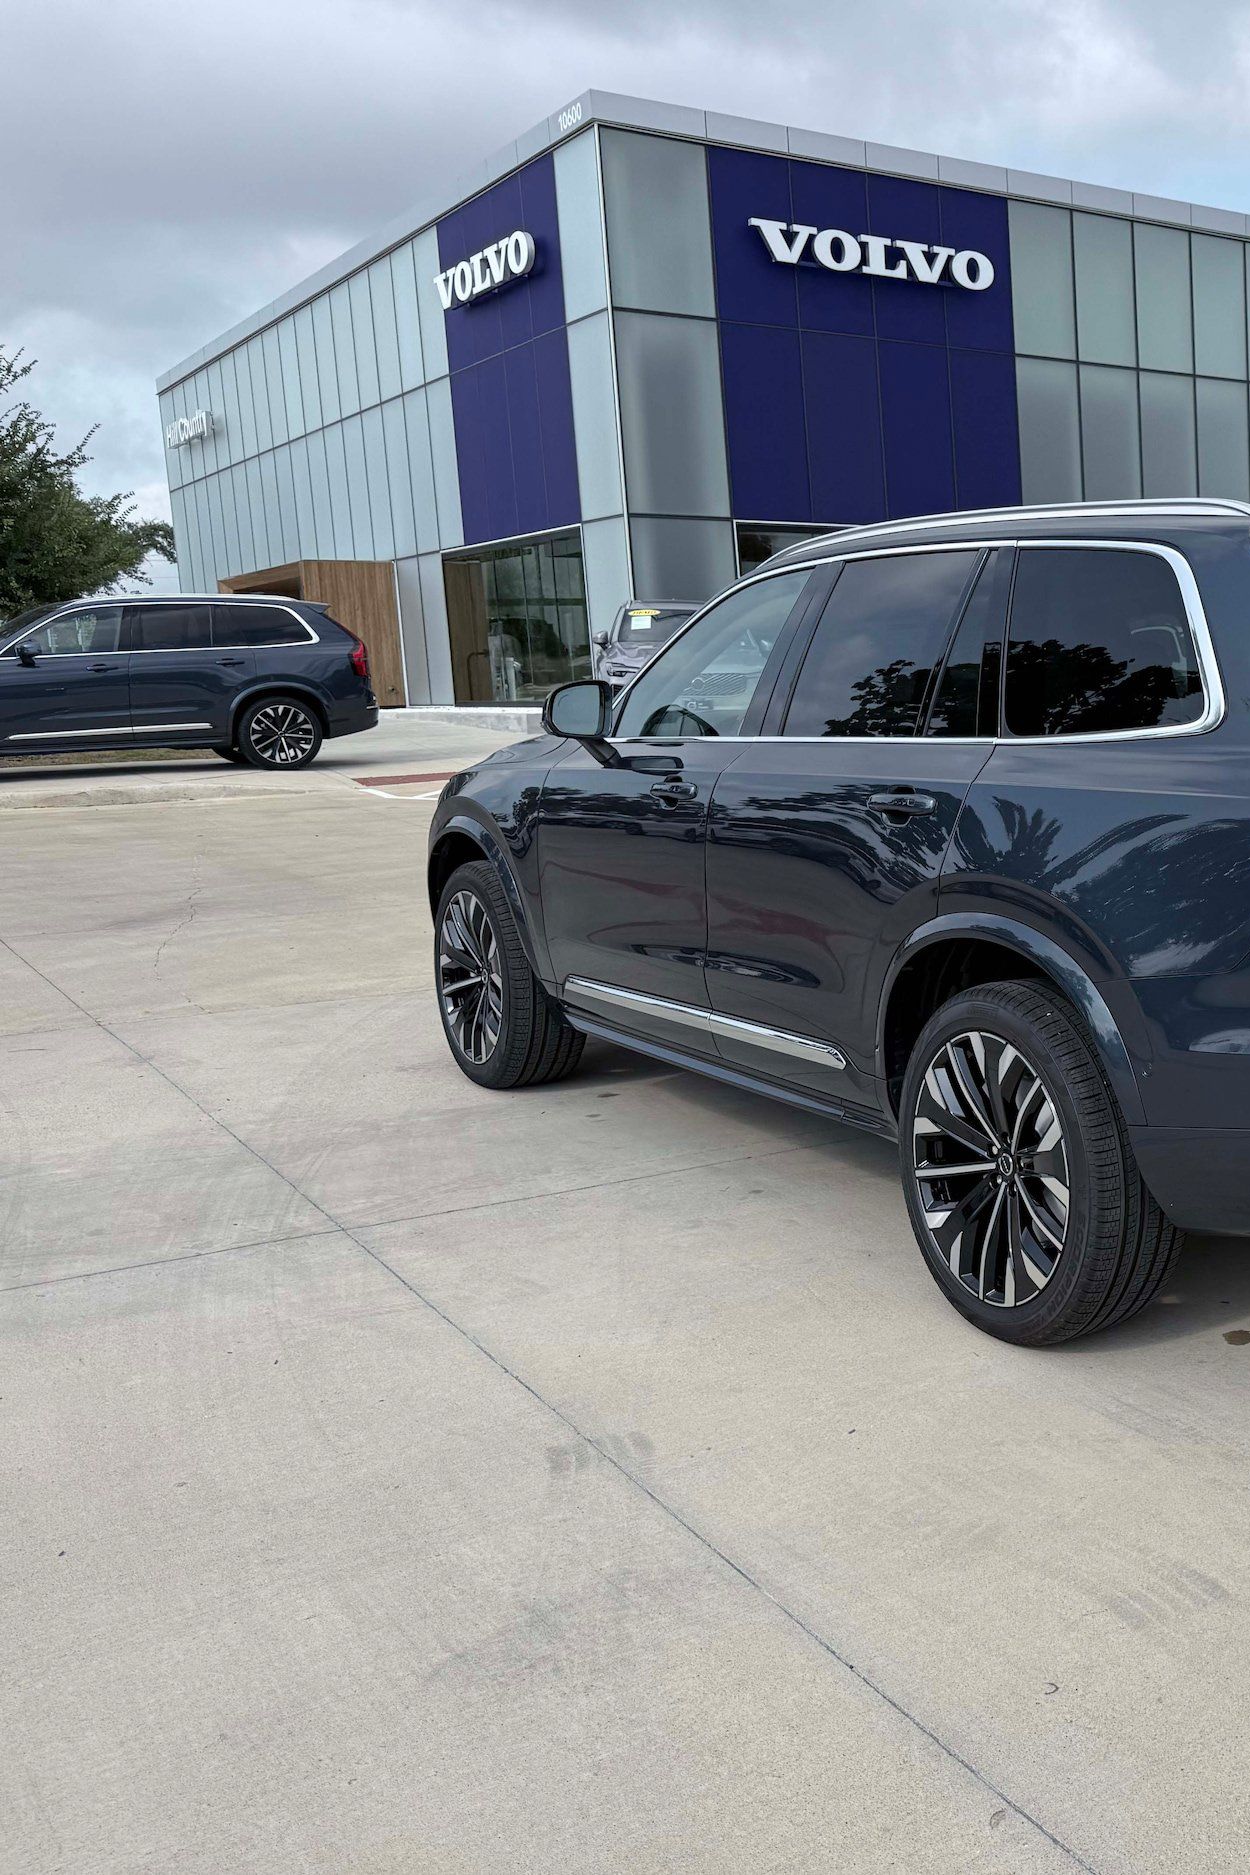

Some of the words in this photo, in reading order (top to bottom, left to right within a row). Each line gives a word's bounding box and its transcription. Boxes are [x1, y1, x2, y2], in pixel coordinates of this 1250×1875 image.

[558, 102, 582, 132] 10600
[433, 230, 532, 310] VOLVO
[748, 217, 995, 291] VOLVO
[178, 410, 207, 442] Country
